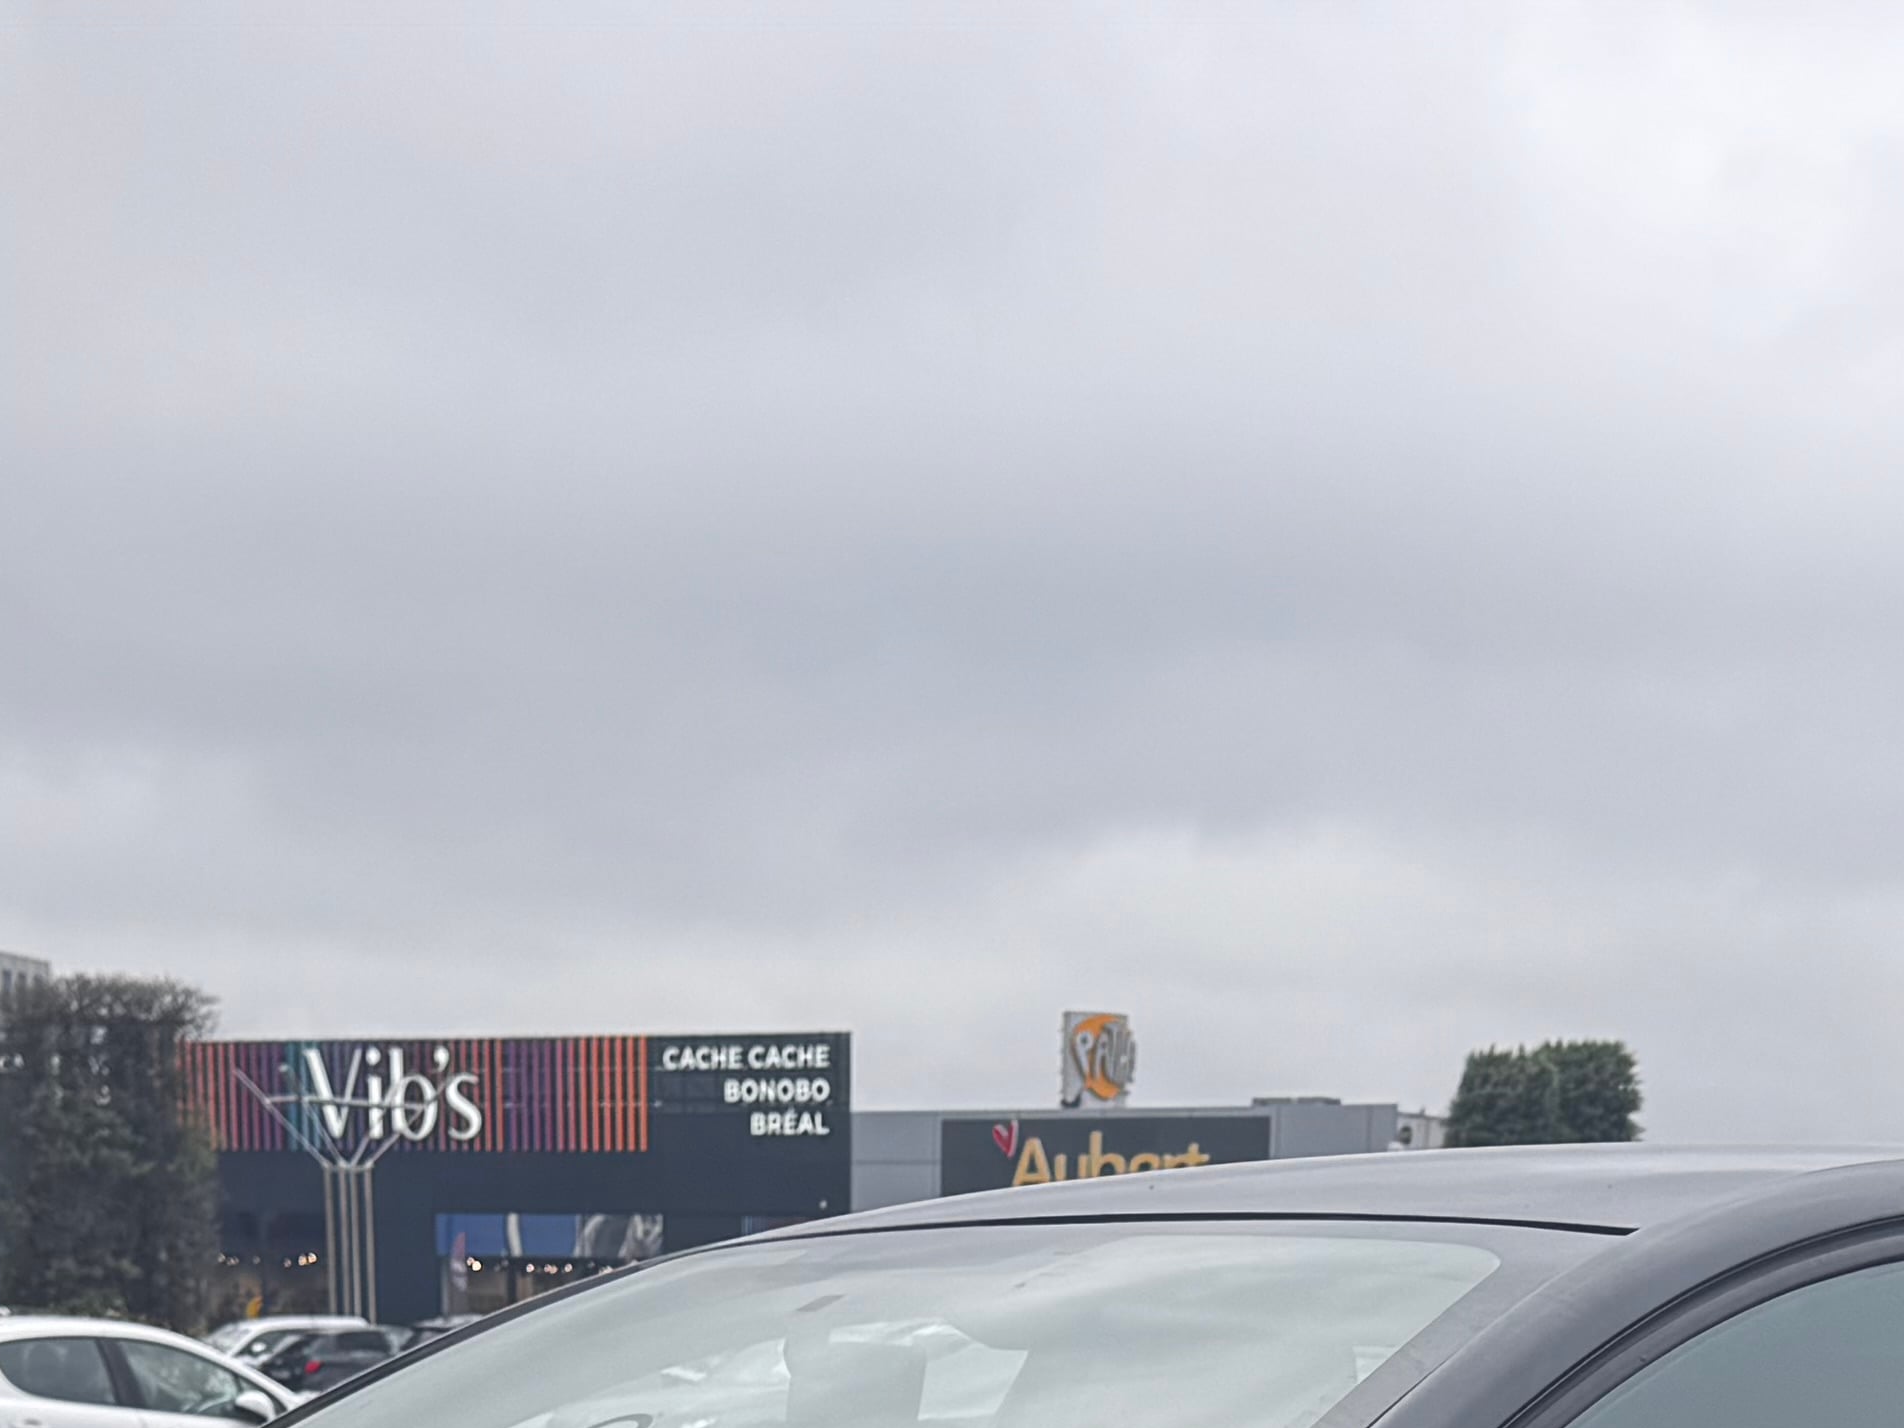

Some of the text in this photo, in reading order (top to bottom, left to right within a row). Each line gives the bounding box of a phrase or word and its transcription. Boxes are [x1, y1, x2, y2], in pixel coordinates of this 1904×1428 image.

[662, 1045, 831, 1070] CACHE CACHE
[303, 1046, 482, 1141] Vib's
[724, 1077, 831, 1104] BONOBO
[750, 1106, 830, 1136] BRÉAL
